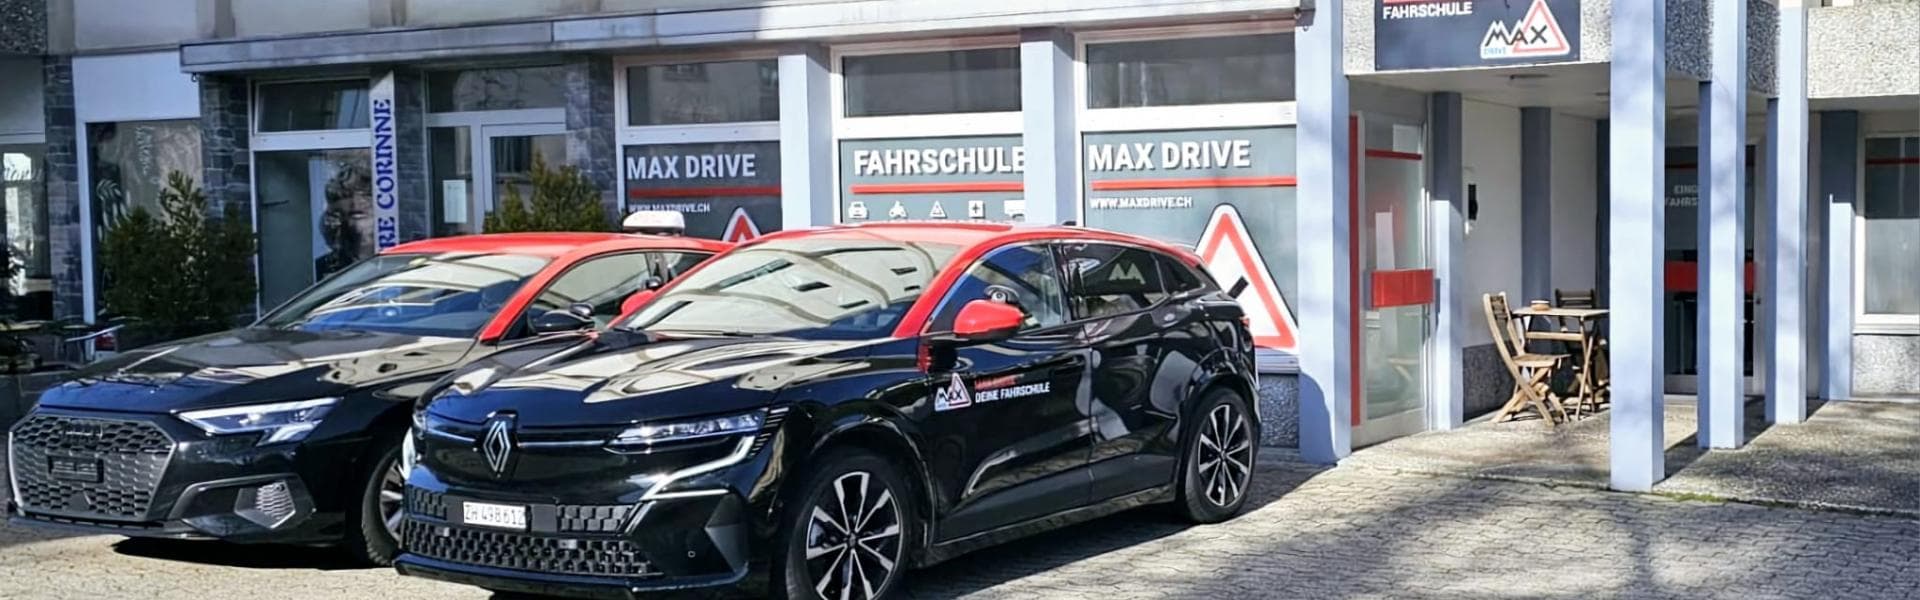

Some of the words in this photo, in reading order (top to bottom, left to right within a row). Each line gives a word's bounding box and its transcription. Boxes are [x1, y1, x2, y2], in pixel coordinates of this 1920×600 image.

[1383, 2, 1473, 19] FAHRSCHULE
[1485, 24, 1548, 47] MAX
[374, 99, 395, 209] CORINNE
[1088, 142, 1155, 171] MAX
[1161, 140, 1251, 168] DRIVE
[626, 156, 679, 179] MAX
[685, 153, 756, 178] DRIVE
[1090, 196, 1193, 210] WWW.MAXDRIVE.CH
[1000, 382, 1050, 399] FAHRSCHULE
